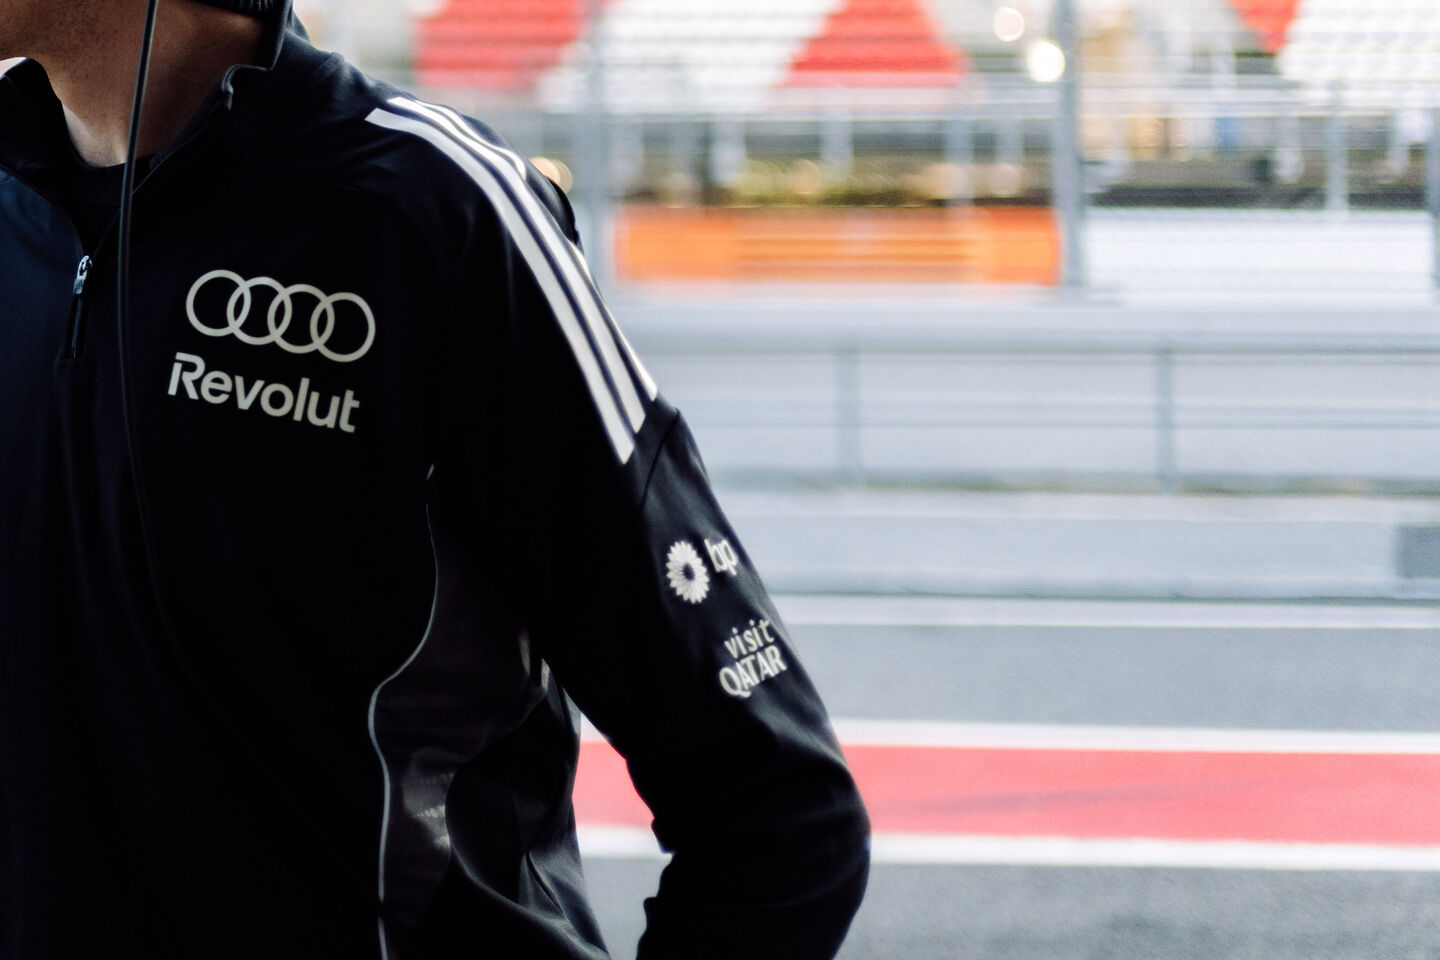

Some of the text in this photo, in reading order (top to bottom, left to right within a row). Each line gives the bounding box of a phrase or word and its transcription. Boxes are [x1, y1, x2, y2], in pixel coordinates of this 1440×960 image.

[168, 352, 360, 433] Revolut
[704, 538, 739, 576] bp
[724, 619, 774, 659] visit
[719, 645, 787, 698] QATAR
